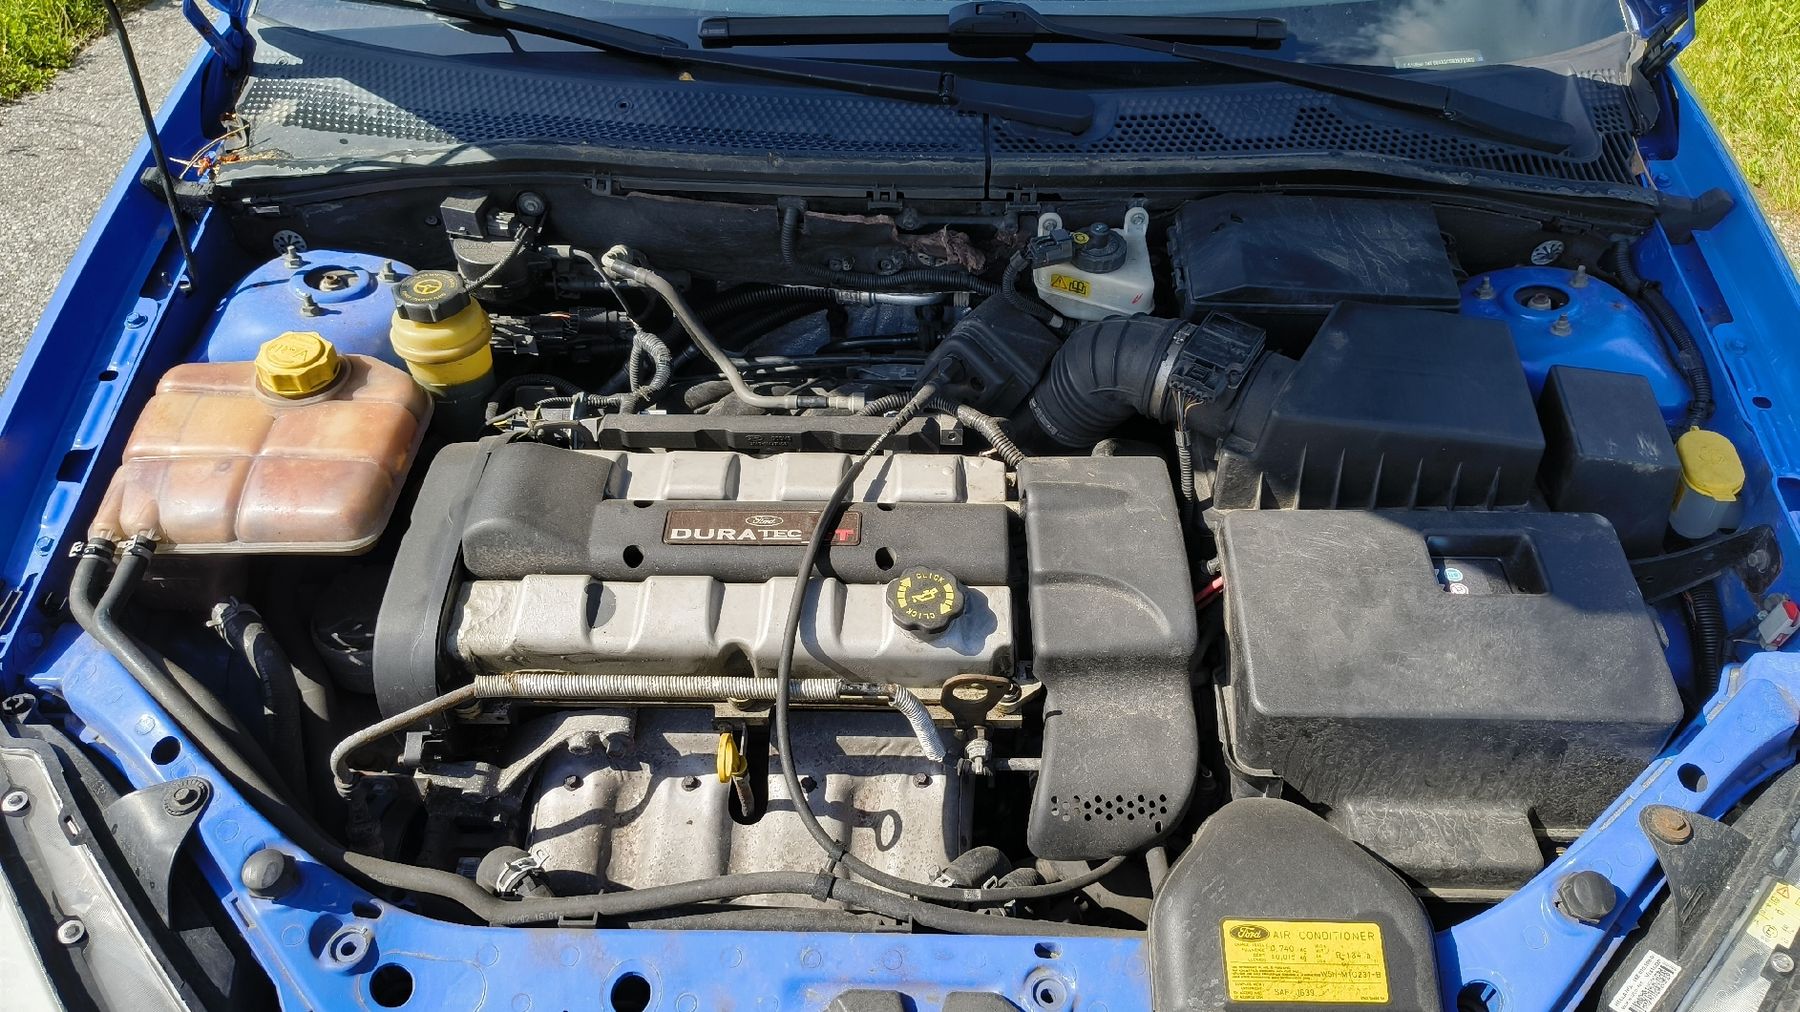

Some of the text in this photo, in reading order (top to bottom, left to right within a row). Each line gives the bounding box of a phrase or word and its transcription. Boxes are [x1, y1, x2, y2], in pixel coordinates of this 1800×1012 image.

[750, 515, 778, 525] Ford
[915, 572, 945, 584] CLICK
[906, 607, 936, 620] CLICK
[1235, 926, 1264, 940] Ford
[1273, 930, 1375, 941] AIR CONDITIONER
